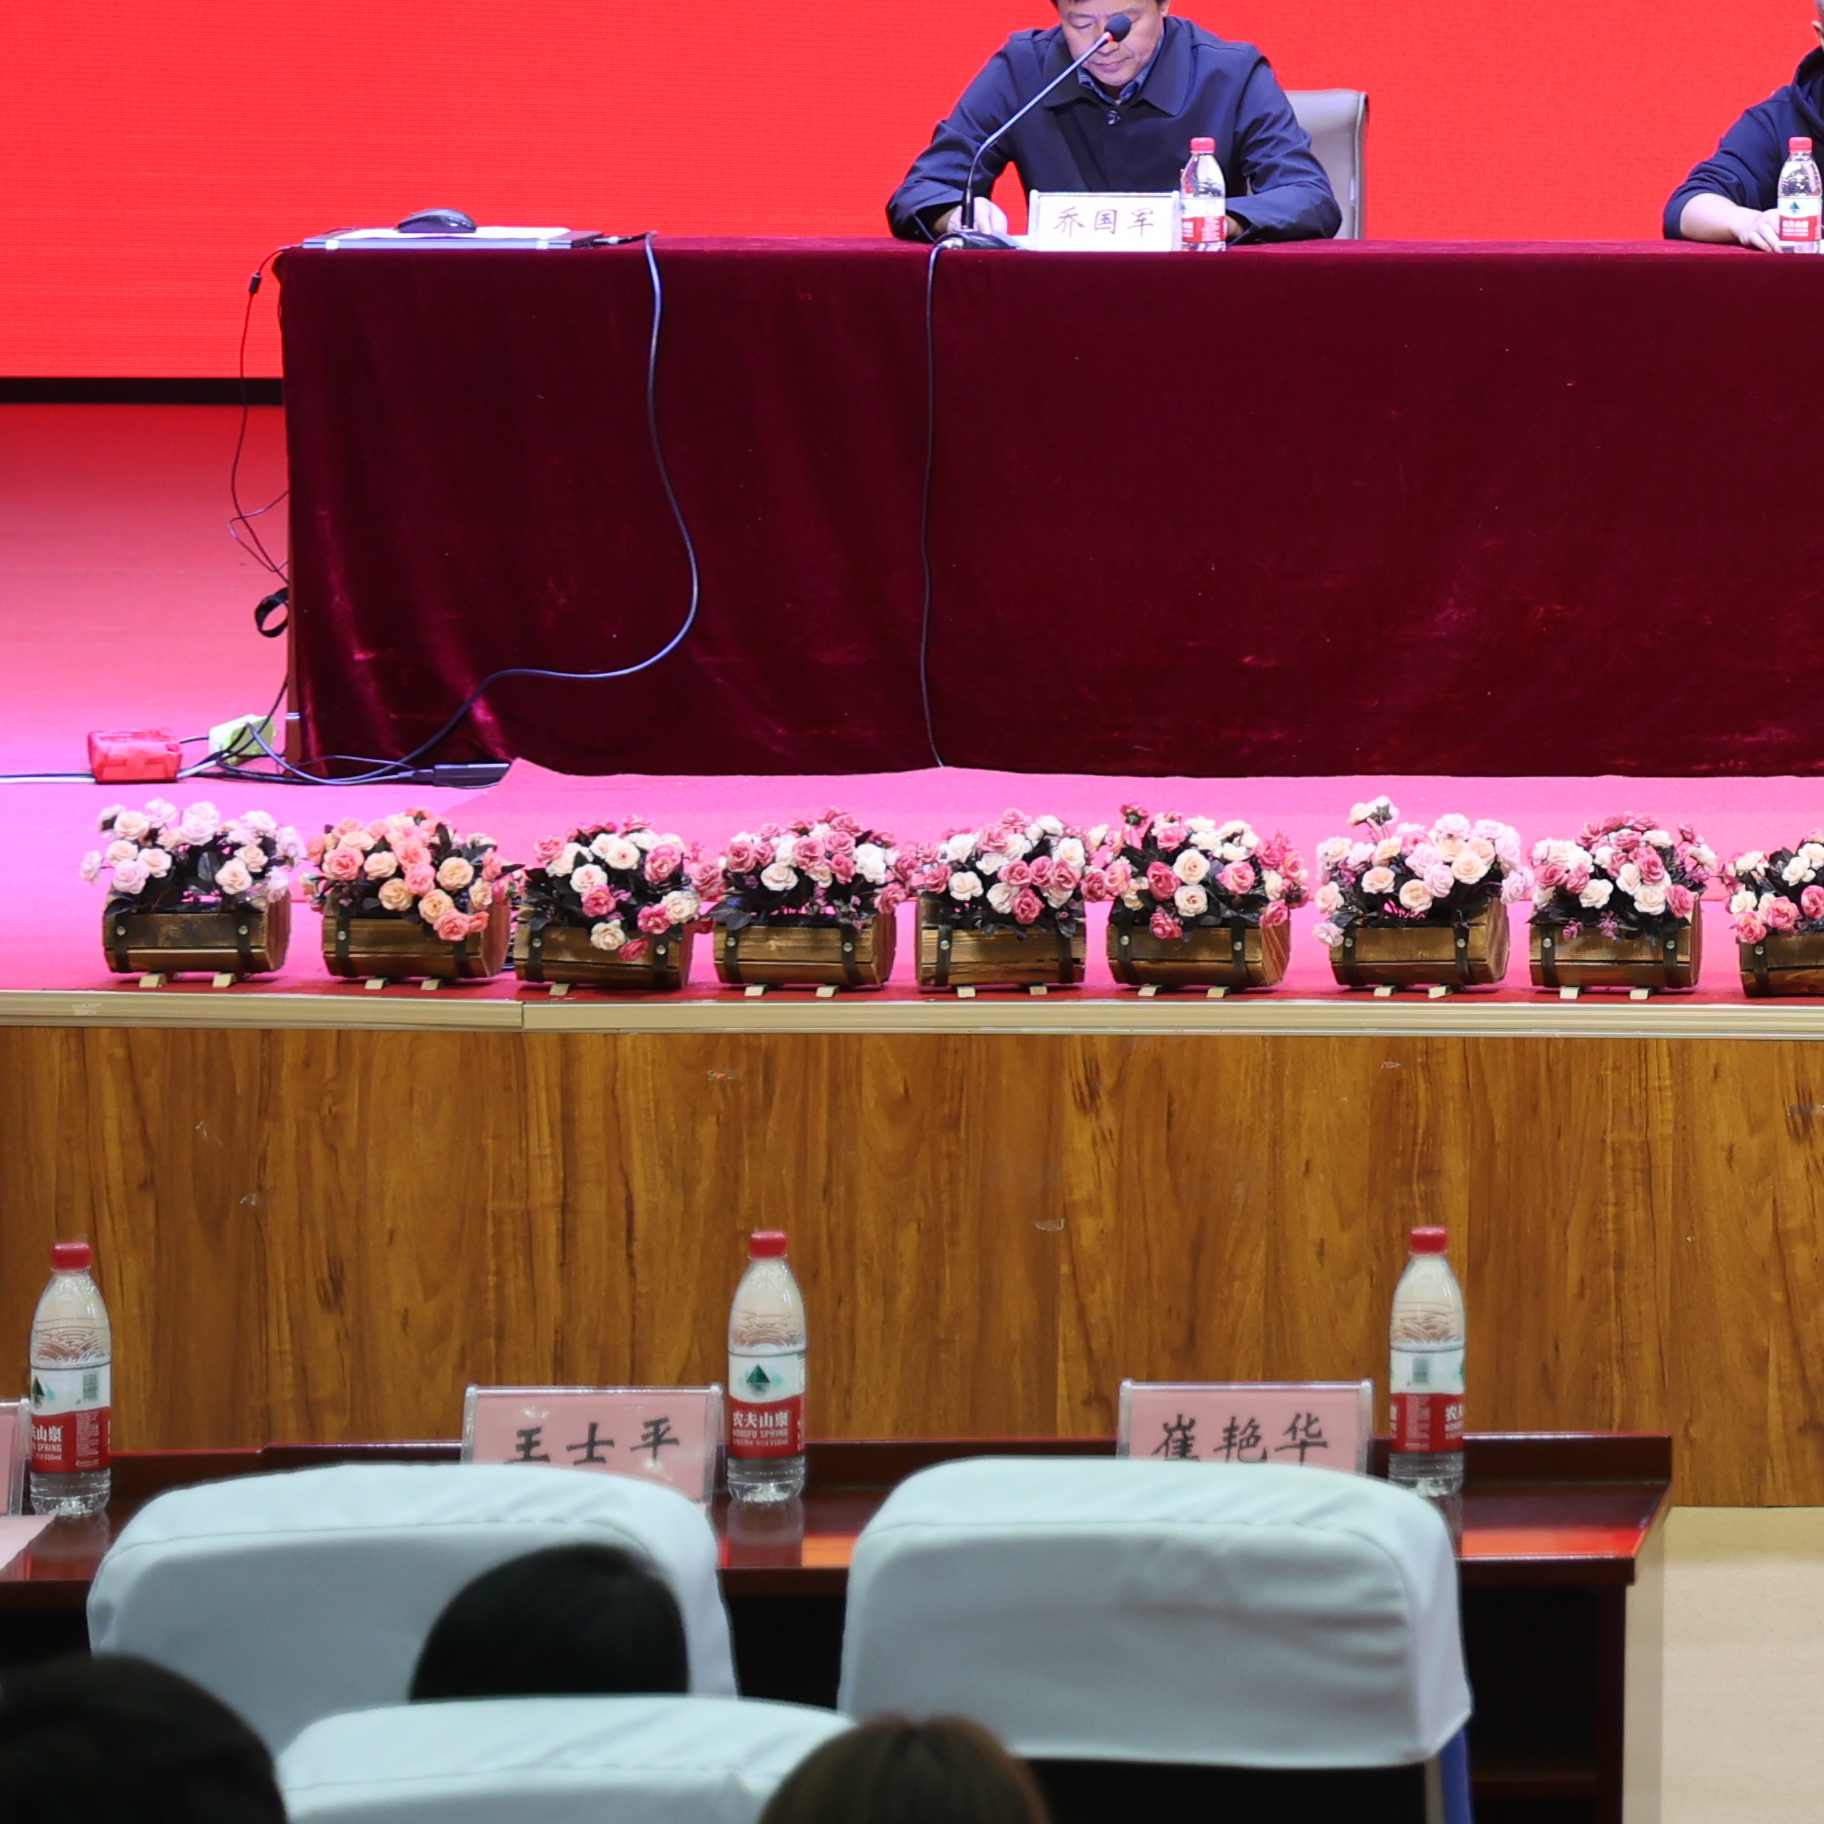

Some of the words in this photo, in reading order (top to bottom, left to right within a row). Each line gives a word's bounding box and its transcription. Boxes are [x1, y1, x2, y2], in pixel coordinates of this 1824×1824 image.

[503, 1416, 681, 1466] 王士平
[1151, 1412, 1329, 1466] 崔艳华
